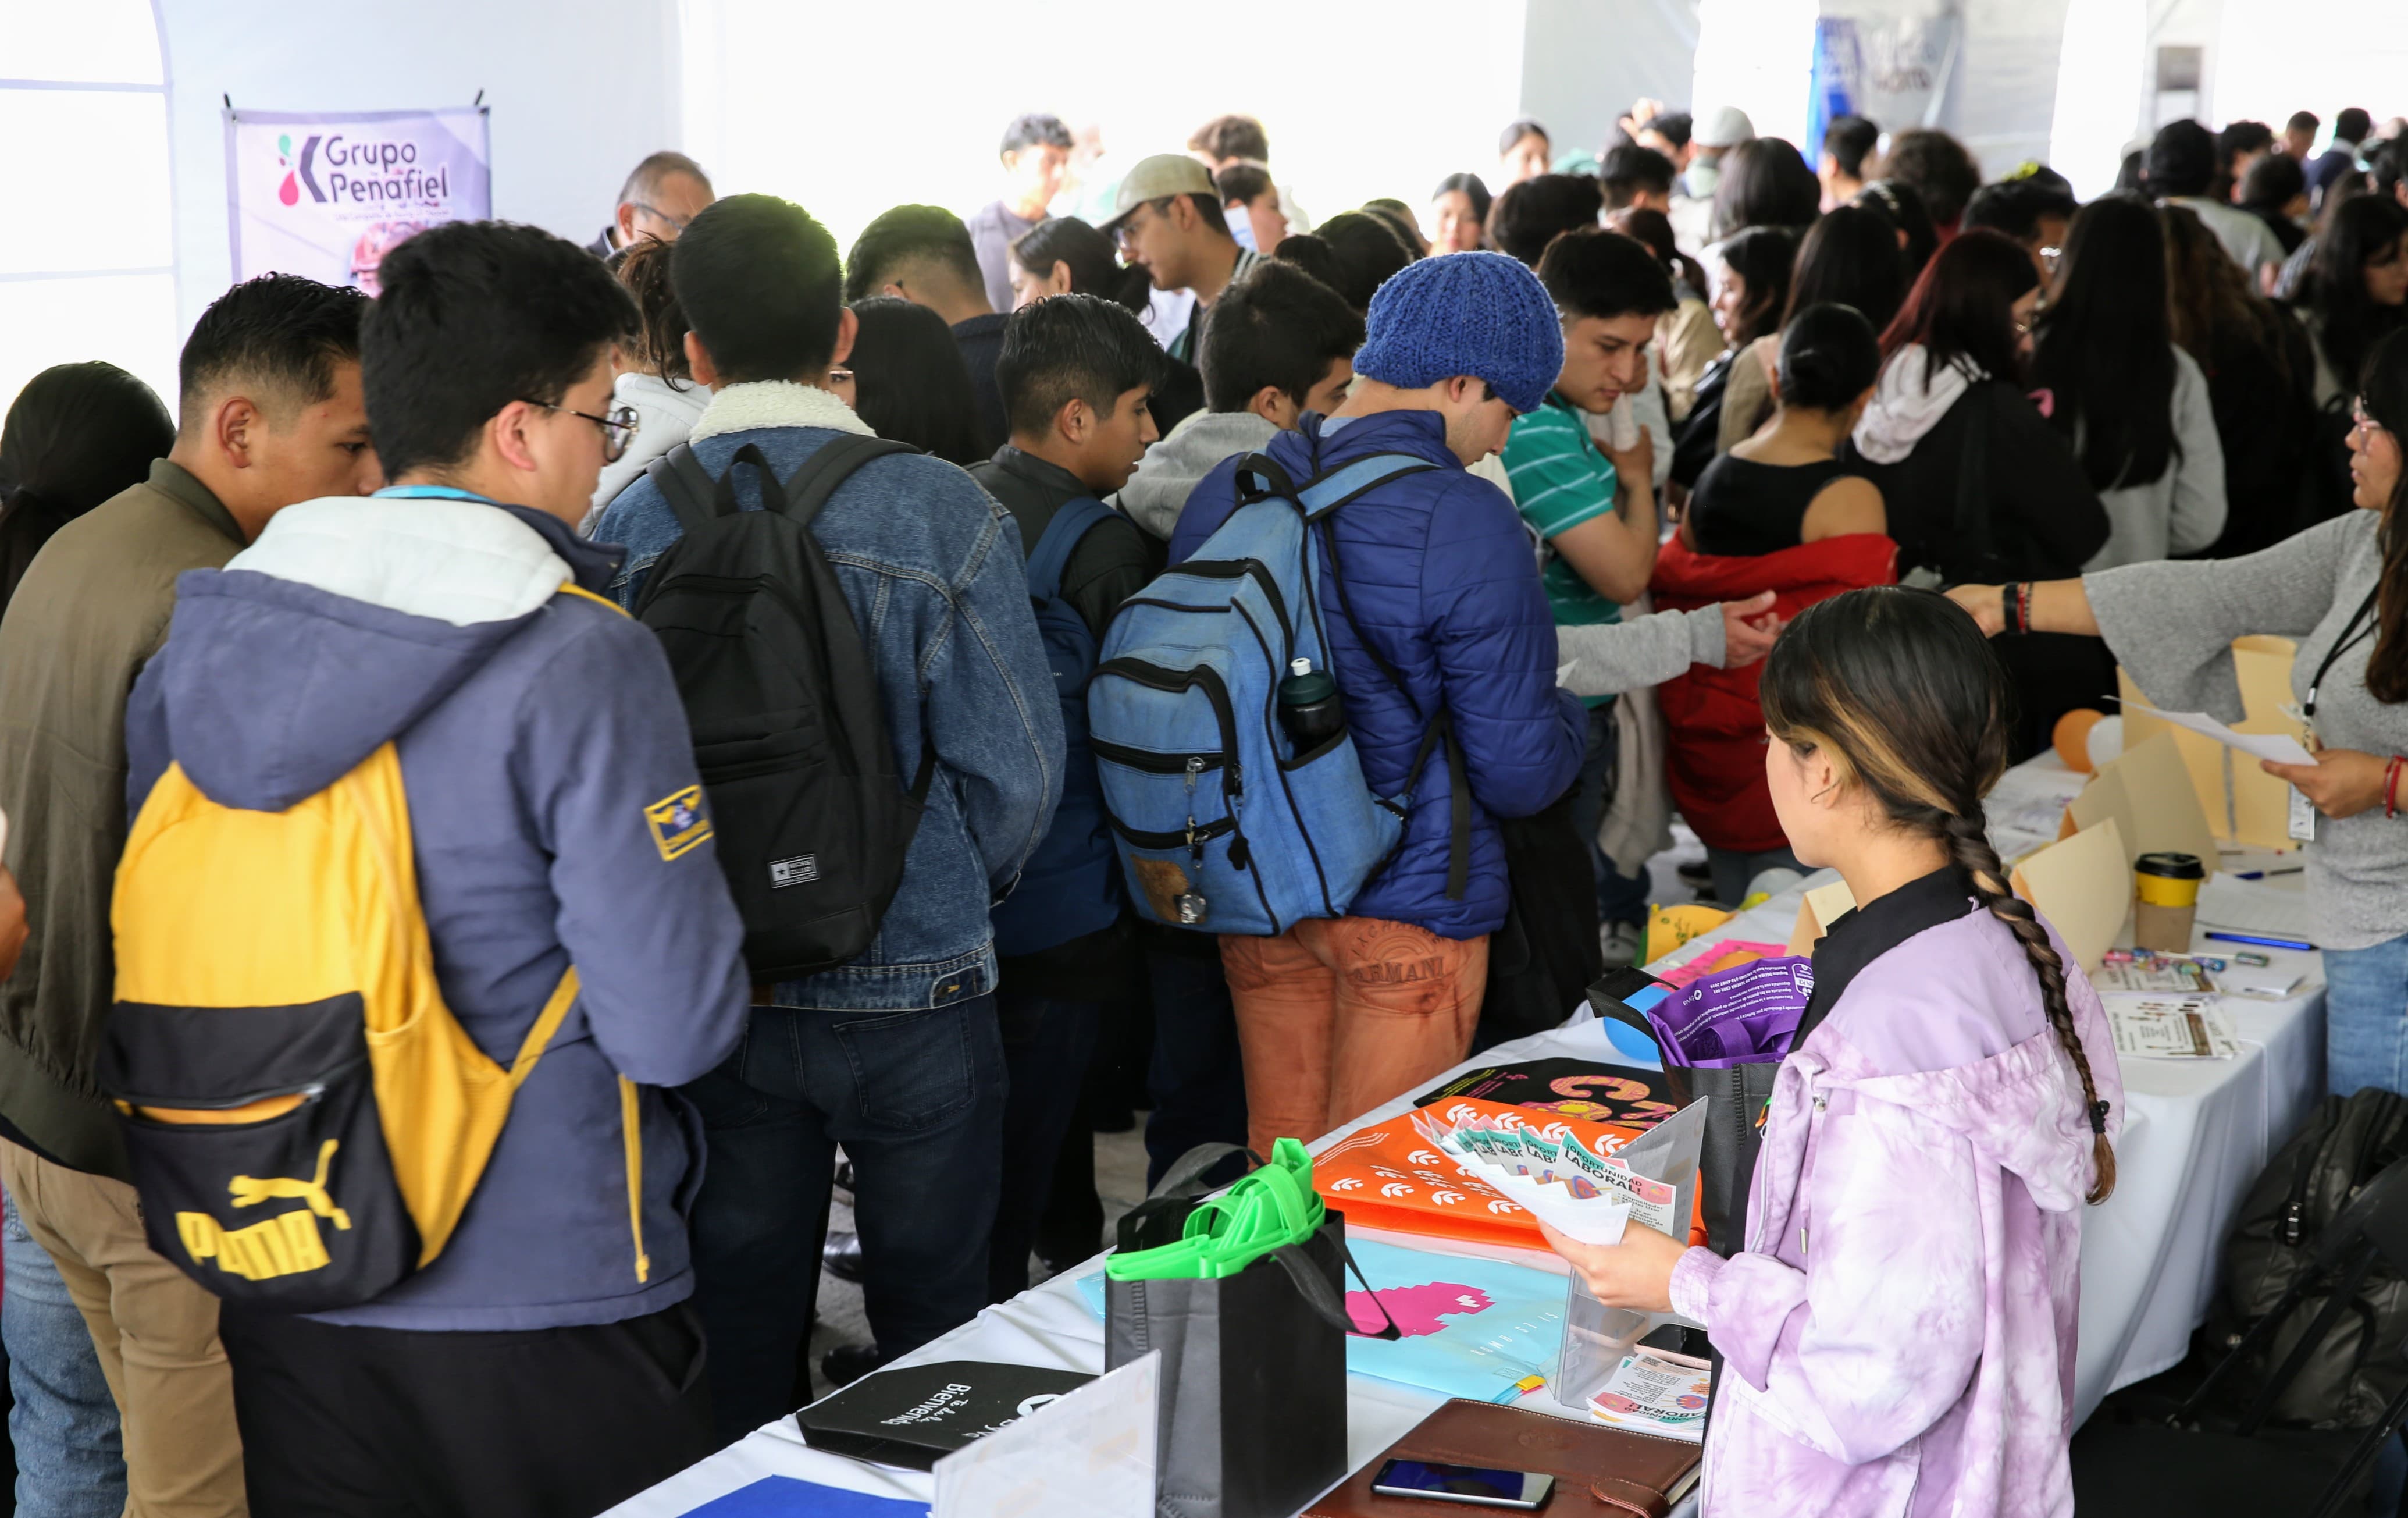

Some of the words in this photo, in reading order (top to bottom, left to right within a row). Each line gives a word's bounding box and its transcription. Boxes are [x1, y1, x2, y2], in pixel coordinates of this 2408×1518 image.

[326, 136, 416, 173] Grupo
[1353, 956, 1445, 982] ARMANI
[1565, 1150, 1641, 1196] LABORAL!
[1566, 1143, 1643, 1187] ¡OPORTUNIDAD
